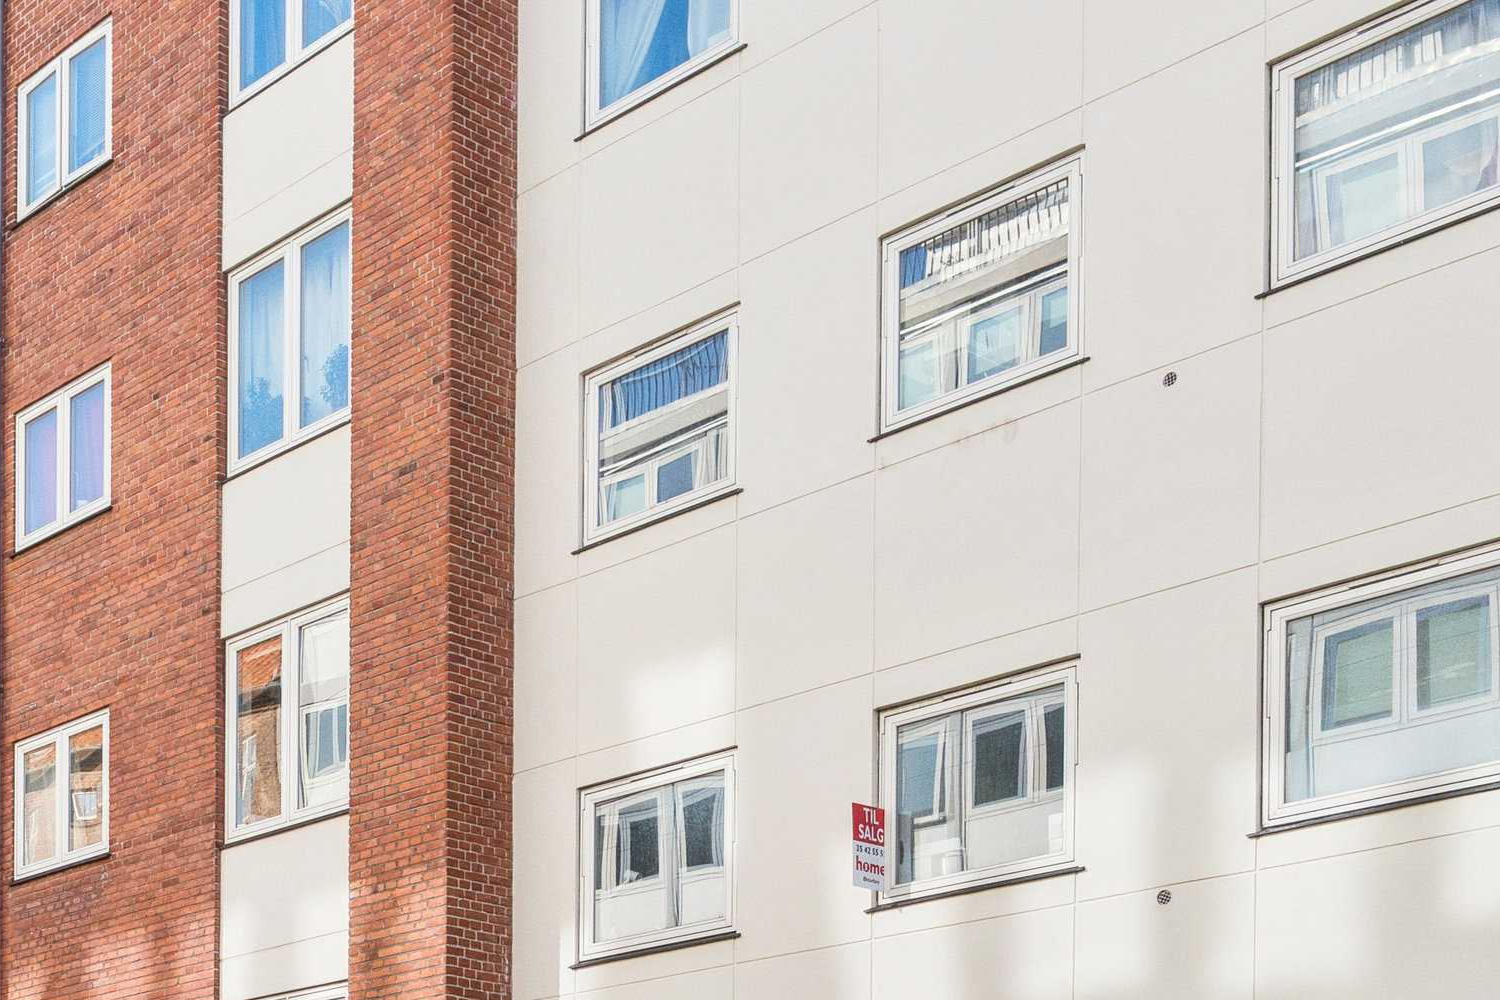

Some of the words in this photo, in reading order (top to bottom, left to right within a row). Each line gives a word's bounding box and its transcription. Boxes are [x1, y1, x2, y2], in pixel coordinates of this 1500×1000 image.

[863, 808, 879, 825] TIL
[859, 824, 884, 843] SALG
[856, 844, 863, 852] 35
[864, 846, 871, 855] 42
[872, 847, 879, 856] 55
[856, 855, 885, 876] home
